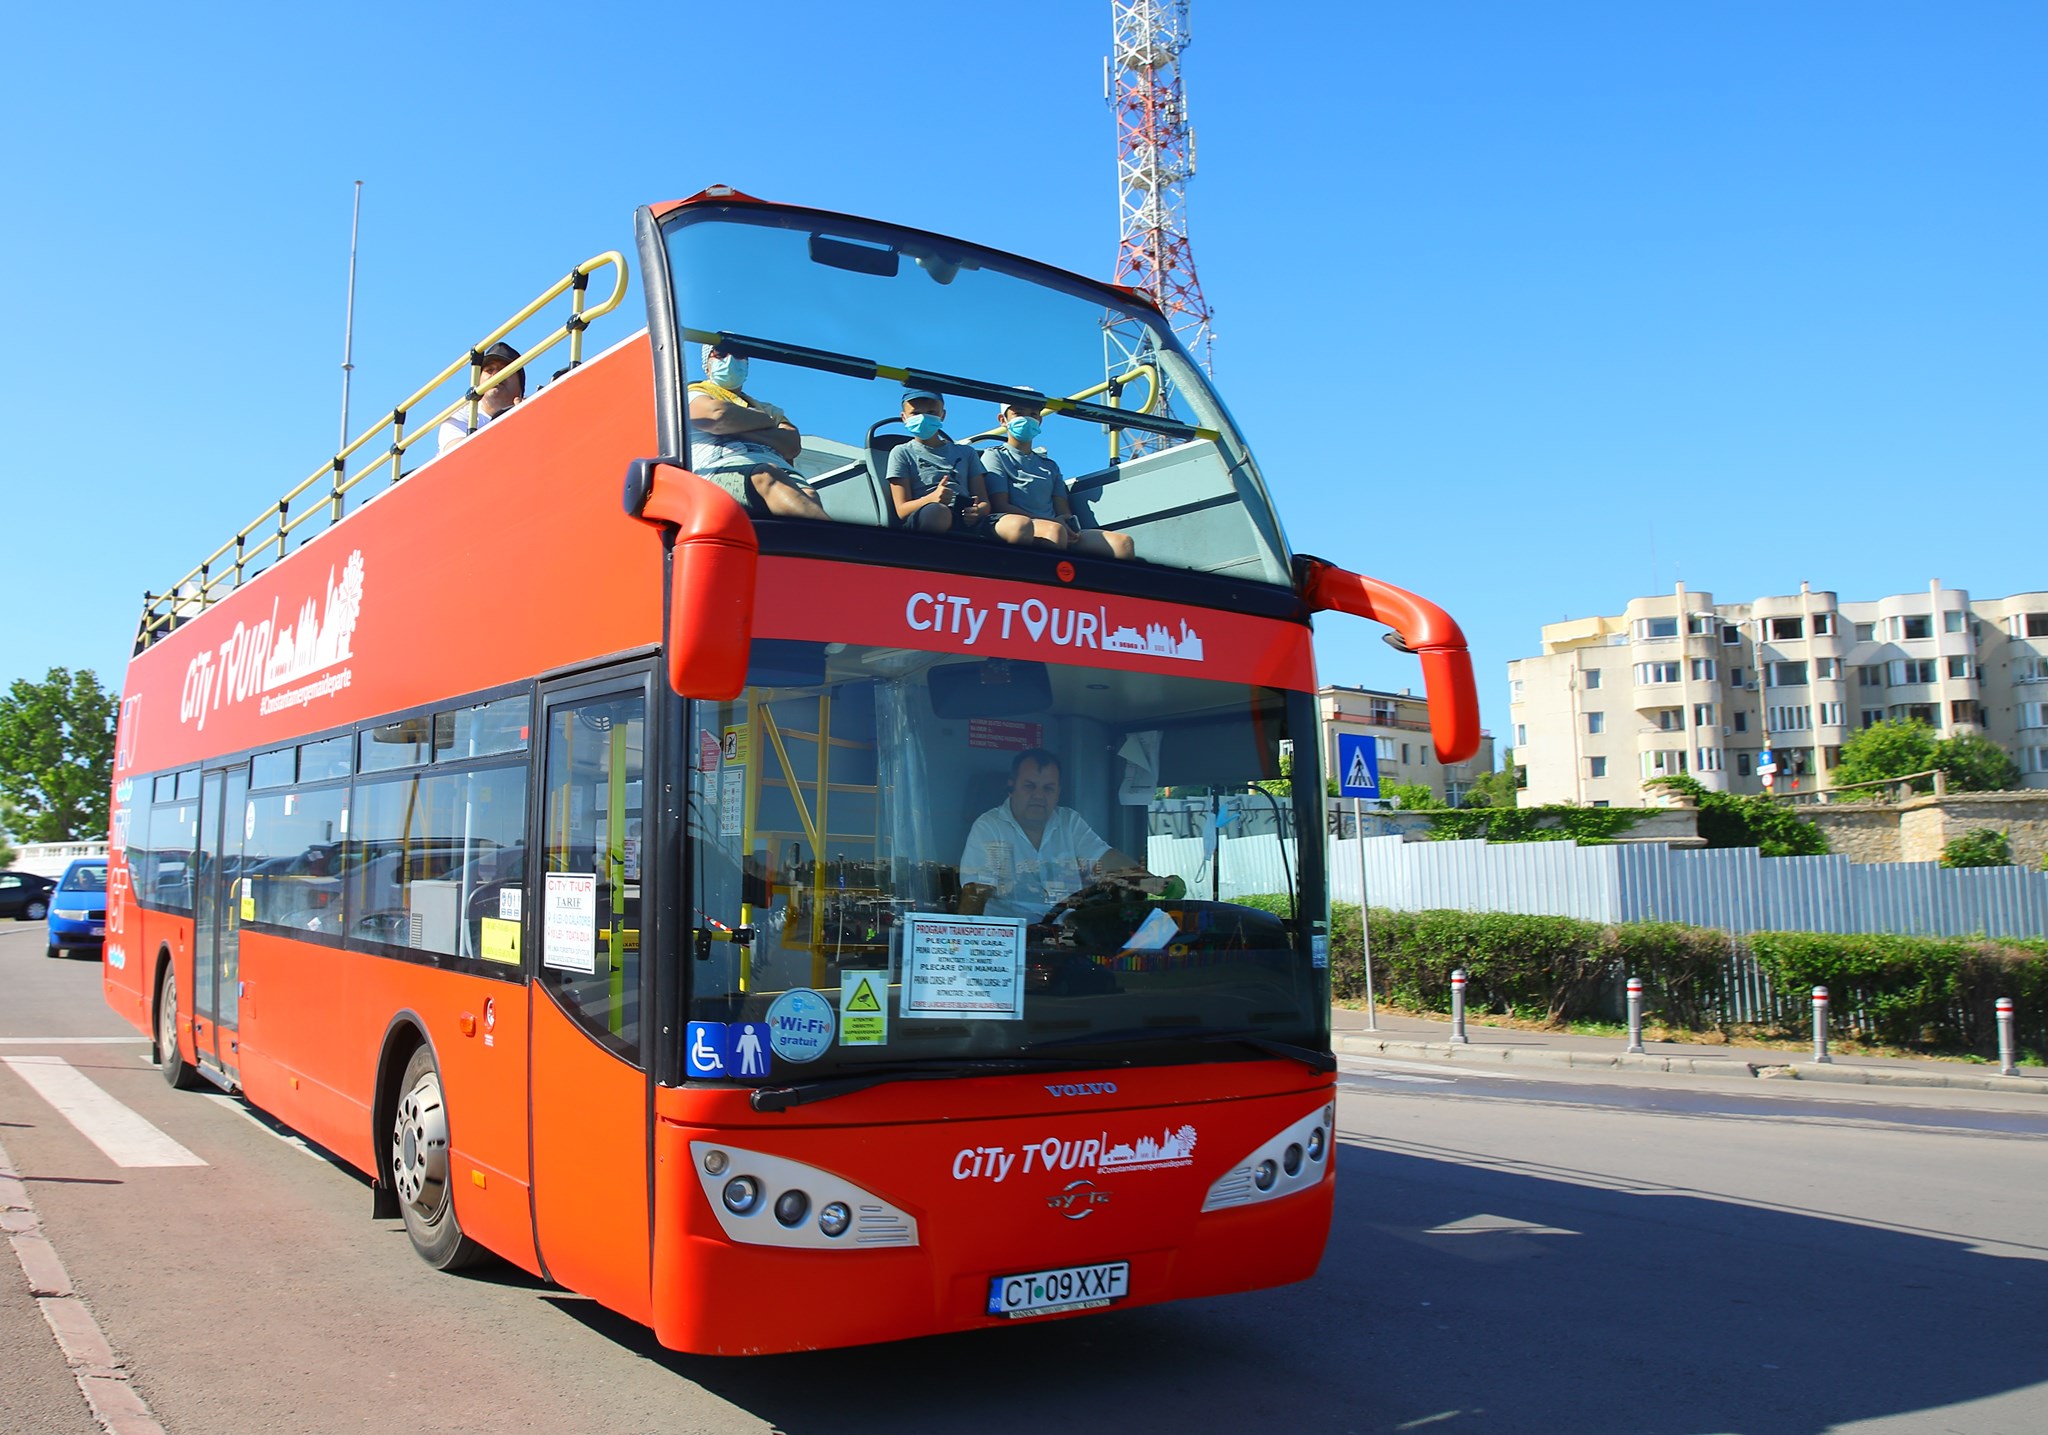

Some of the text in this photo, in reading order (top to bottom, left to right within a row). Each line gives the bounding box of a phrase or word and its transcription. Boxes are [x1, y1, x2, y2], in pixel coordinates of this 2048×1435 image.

[997, 598, 1098, 649] TOUR
[214, 619, 271, 710] TOUR
[556, 896, 582, 907] TARIF
[916, 924, 947, 935] PROGRAM
[949, 926, 985, 936] TRANSPORT
[926, 937, 961, 945] PLECARE
[920, 963, 955, 971] PLECARE
[958, 964, 973, 972] DIN
[780, 1015, 824, 1034] Wi-Fi
[780, 1035, 818, 1047] gratuit
[1045, 1082, 1118, 1097] VOLVO
[1022, 1137, 1100, 1174] TOUR
[1006, 1277, 1037, 1307] CT
